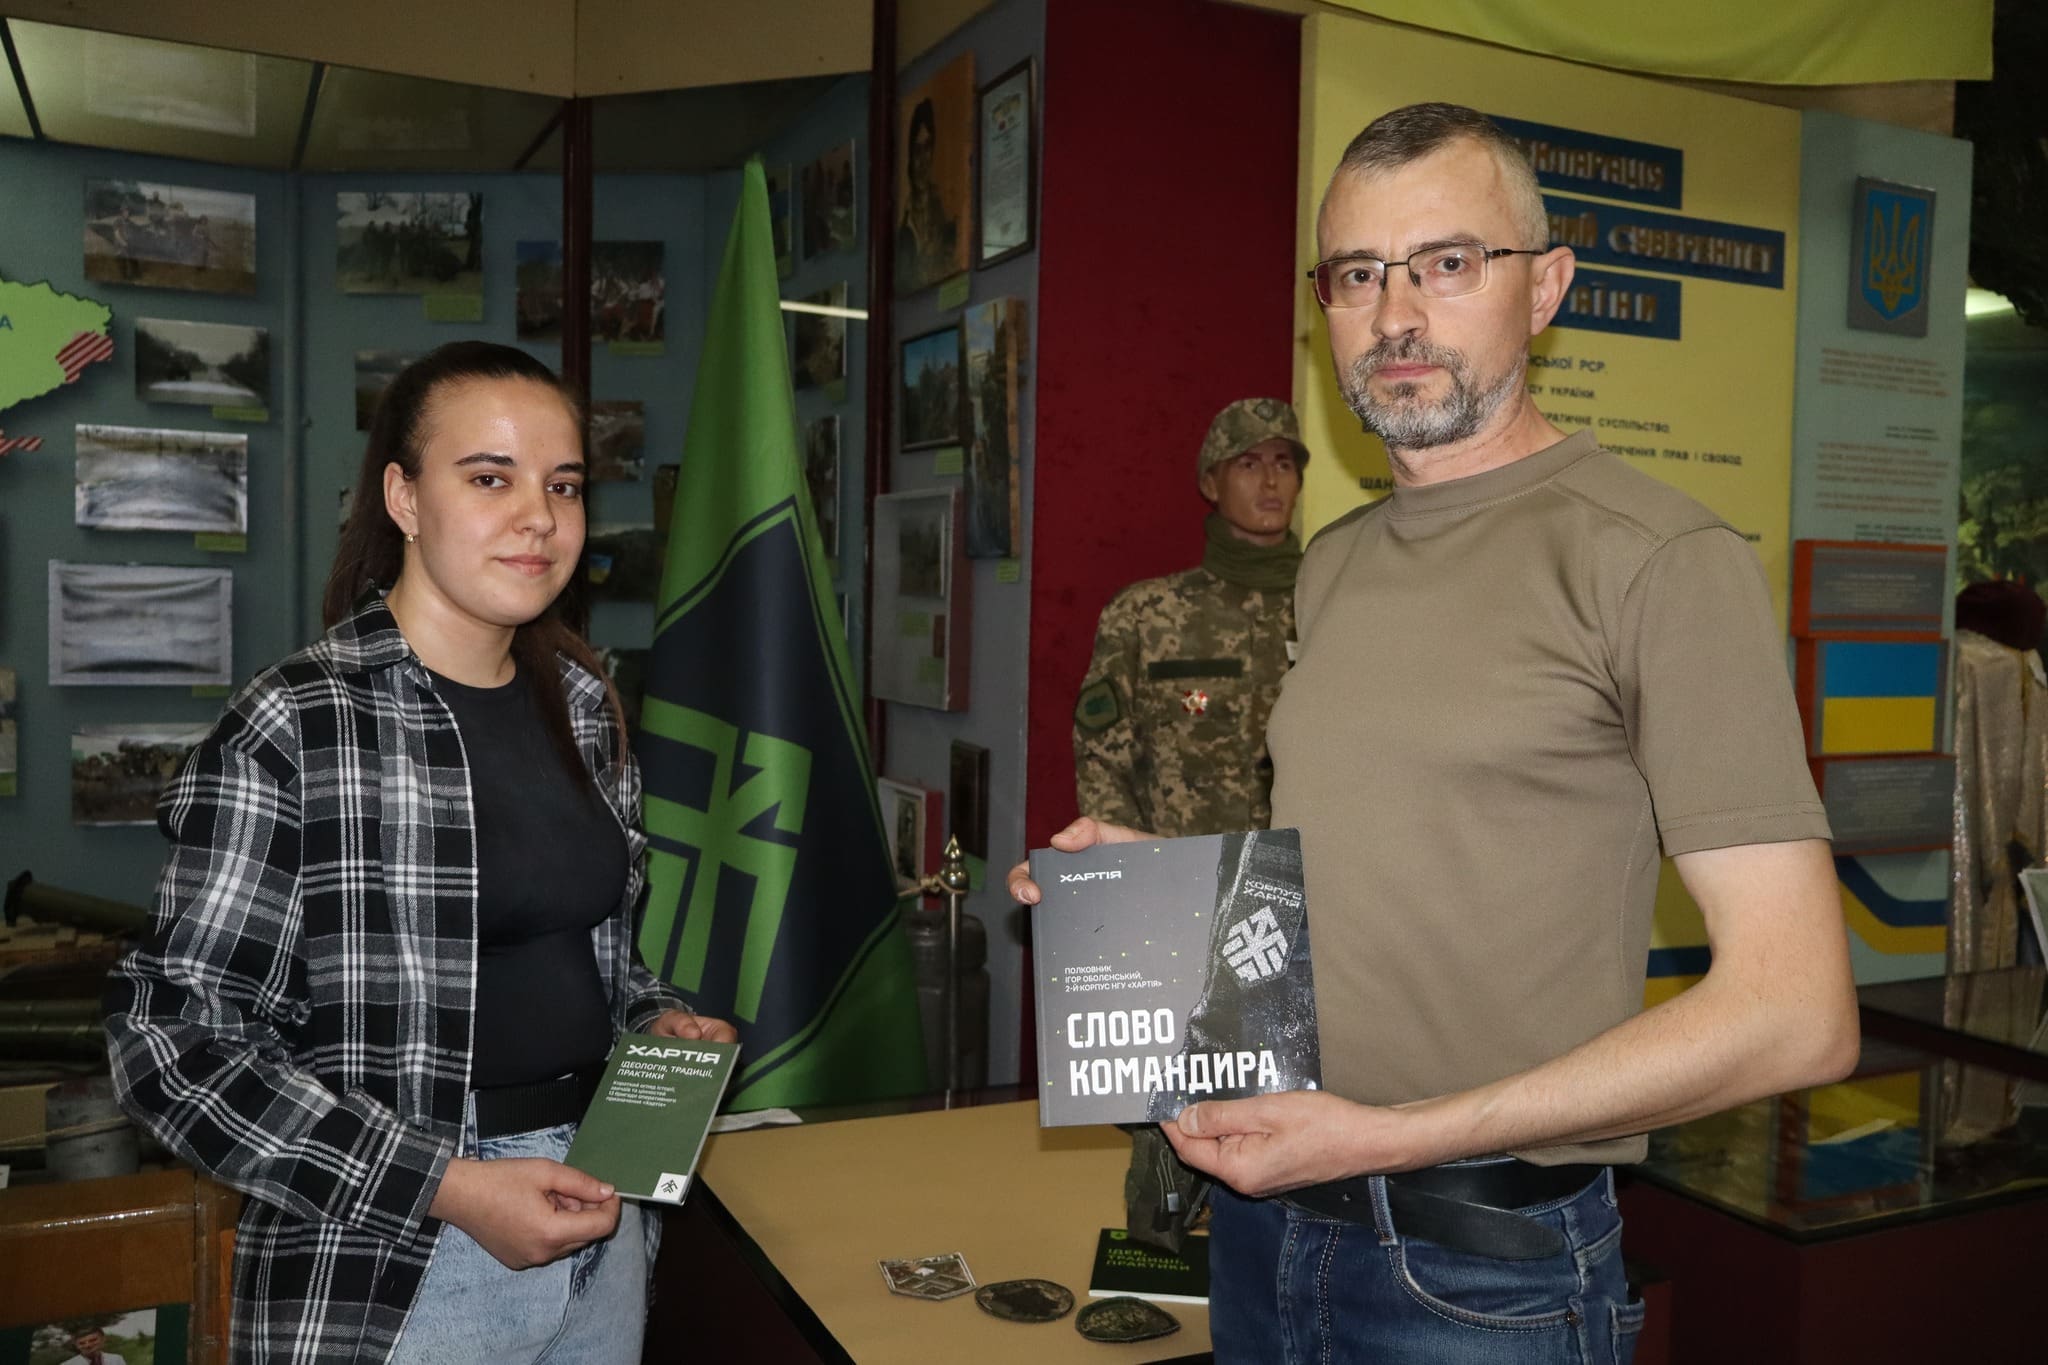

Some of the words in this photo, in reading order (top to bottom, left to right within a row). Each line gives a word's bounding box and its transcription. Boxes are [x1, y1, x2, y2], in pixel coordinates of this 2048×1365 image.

[1531, 140, 1665, 192] КЛАРАЦІЯ
[1549, 211, 1598, 248] НИЙ
[1607, 223, 1776, 273] СУВЕРЕНІТЕТ
[1568, 280, 1658, 322] АЇНИ
[1541, 411, 1592, 426] РАТИЧНЕ
[1060, 869, 1122, 883] ХАРТІЯ
[1064, 965, 1112, 975] ПОЛКОВНИК
[1064, 975, 1081, 984] ІГОР
[1064, 984, 1079, 993] 2-Й
[1080, 983, 1111, 992] КОРПУС
[1111, 982, 1127, 990] НГУ
[1127, 980, 1163, 989] «ХАРТІЯ»
[1066, 1007, 1176, 1050] СЛОВО
[626, 1044, 721, 1065] ХАРТІЯ
[616, 1068, 665, 1080] ПРАКТИКИ
[620, 1060, 668, 1073] ІДЕОЛОГІЯ,
[670, 1065, 713, 1079] ТРАДИЦІЇ,
[1069, 1049, 1280, 1097] КОМАНДИРА
